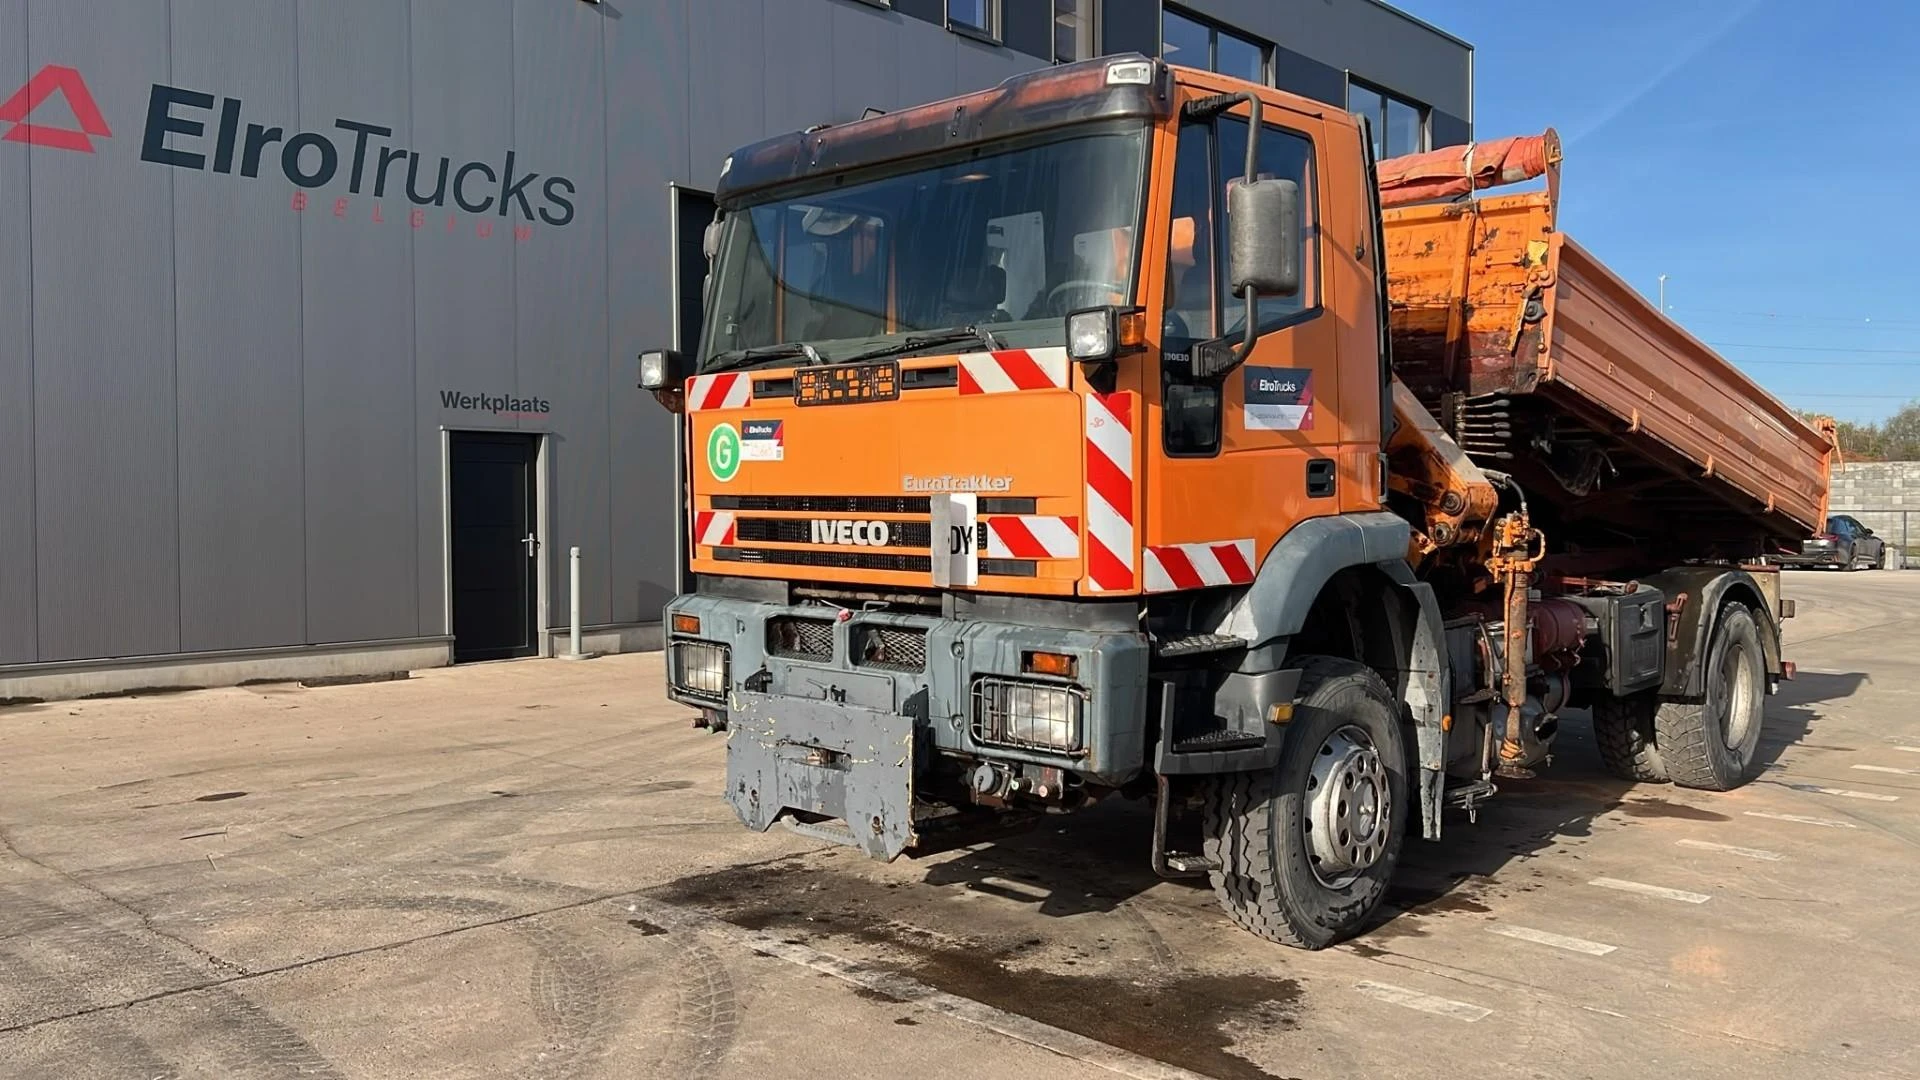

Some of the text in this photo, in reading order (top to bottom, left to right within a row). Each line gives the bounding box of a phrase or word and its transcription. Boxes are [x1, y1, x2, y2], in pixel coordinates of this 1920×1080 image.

[141, 84, 576, 226] ElroTrucks
[291, 191, 533, 241] BELGIUM
[1260, 379, 1297, 392] ElroTrucks
[440, 390, 550, 414] Werkplaats
[716, 435, 732, 470] G
[903, 475, 1014, 492] EuroTrakker
[811, 519, 889, 547] IVECO
[950, 525, 973, 555] DY
